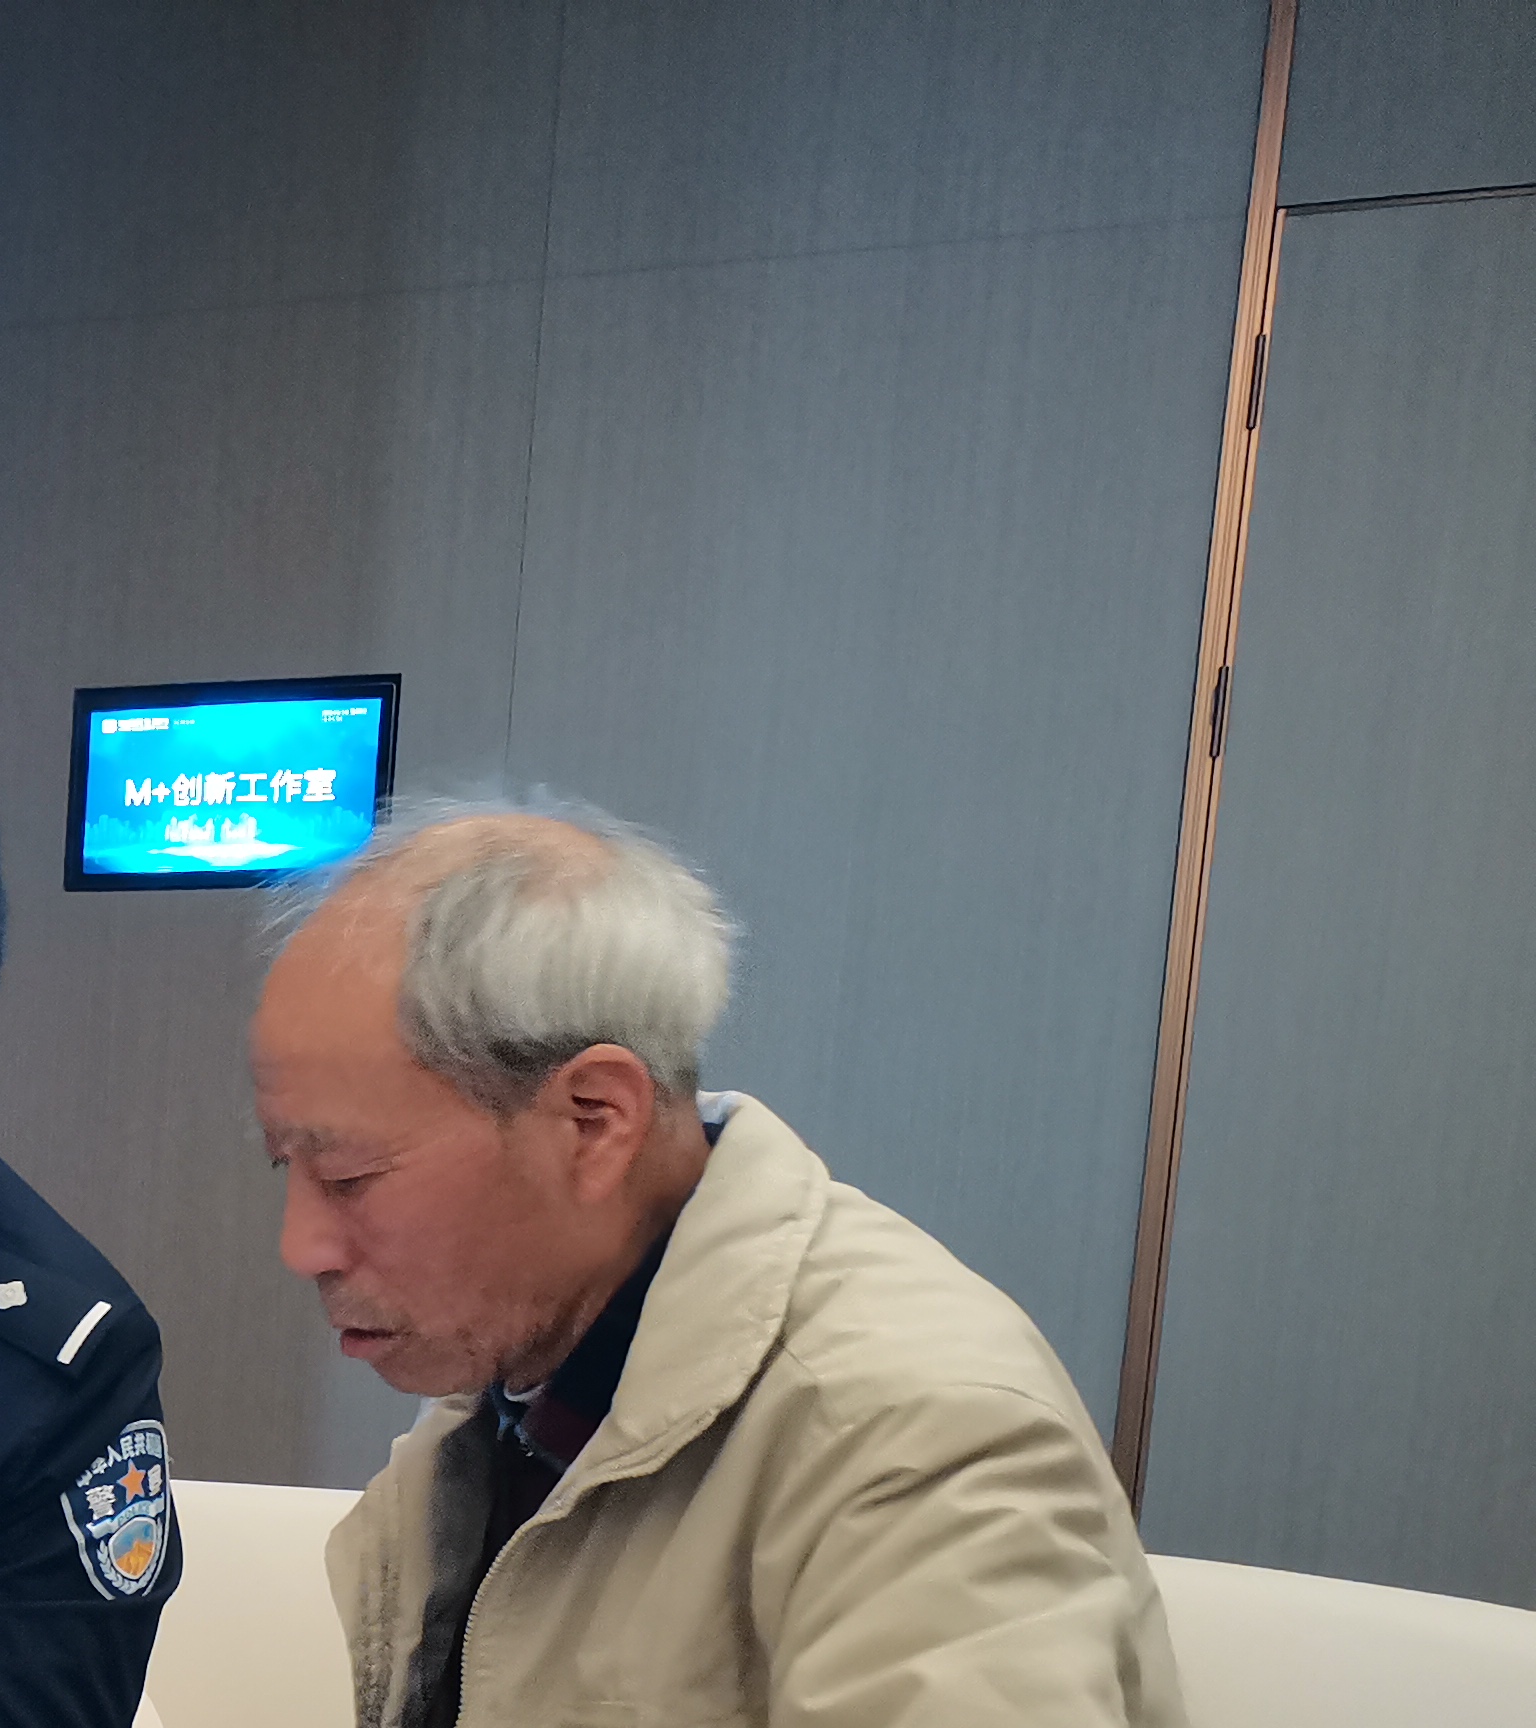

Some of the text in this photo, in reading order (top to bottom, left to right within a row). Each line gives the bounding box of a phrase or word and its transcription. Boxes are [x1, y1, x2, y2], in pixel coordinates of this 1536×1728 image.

[124, 768, 337, 806] M+创新工作室
